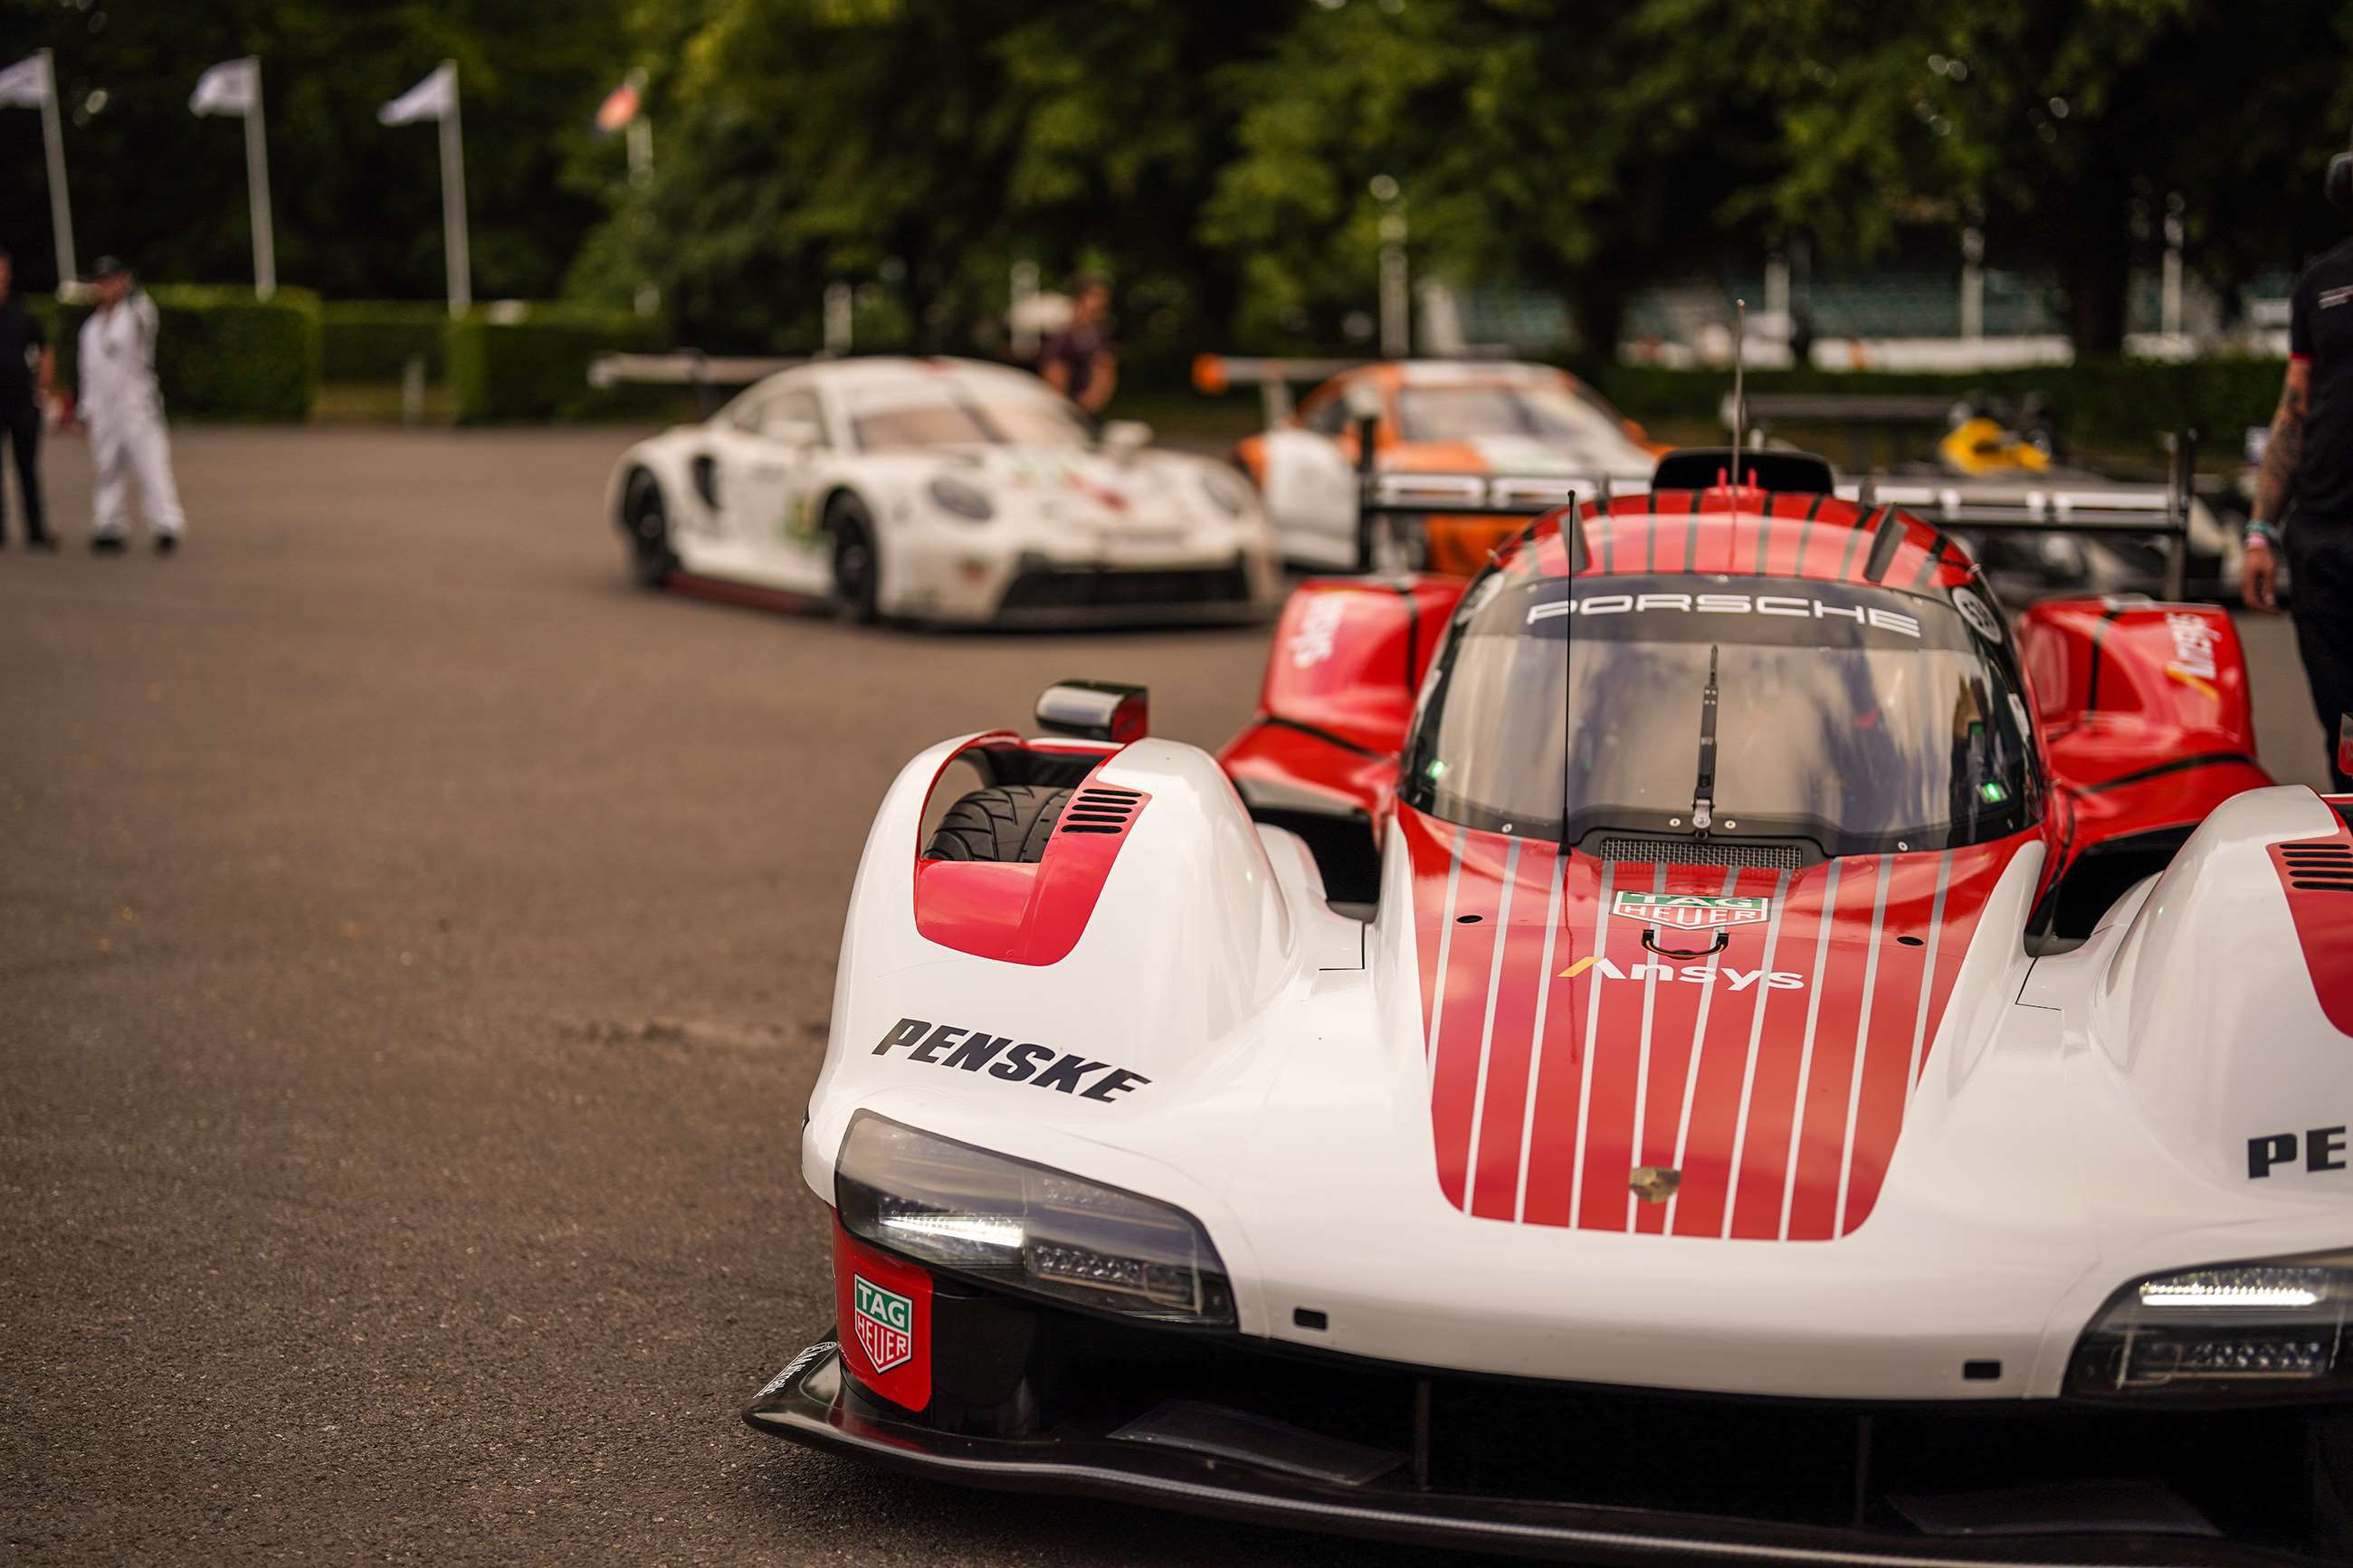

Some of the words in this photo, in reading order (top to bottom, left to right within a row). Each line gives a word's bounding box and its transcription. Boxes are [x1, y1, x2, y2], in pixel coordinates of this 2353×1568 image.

[1527, 594, 1920, 638] PORSCHE
[1624, 905, 1757, 927] HEUER
[1630, 893, 1753, 908] TAG
[1557, 955, 1805, 992] Ansys
[871, 1018, 1152, 1103] PENSKE
[2247, 1126, 2347, 1179] PE
[857, 1282, 906, 1329] TAG
[857, 1314, 907, 1365] HEUER
